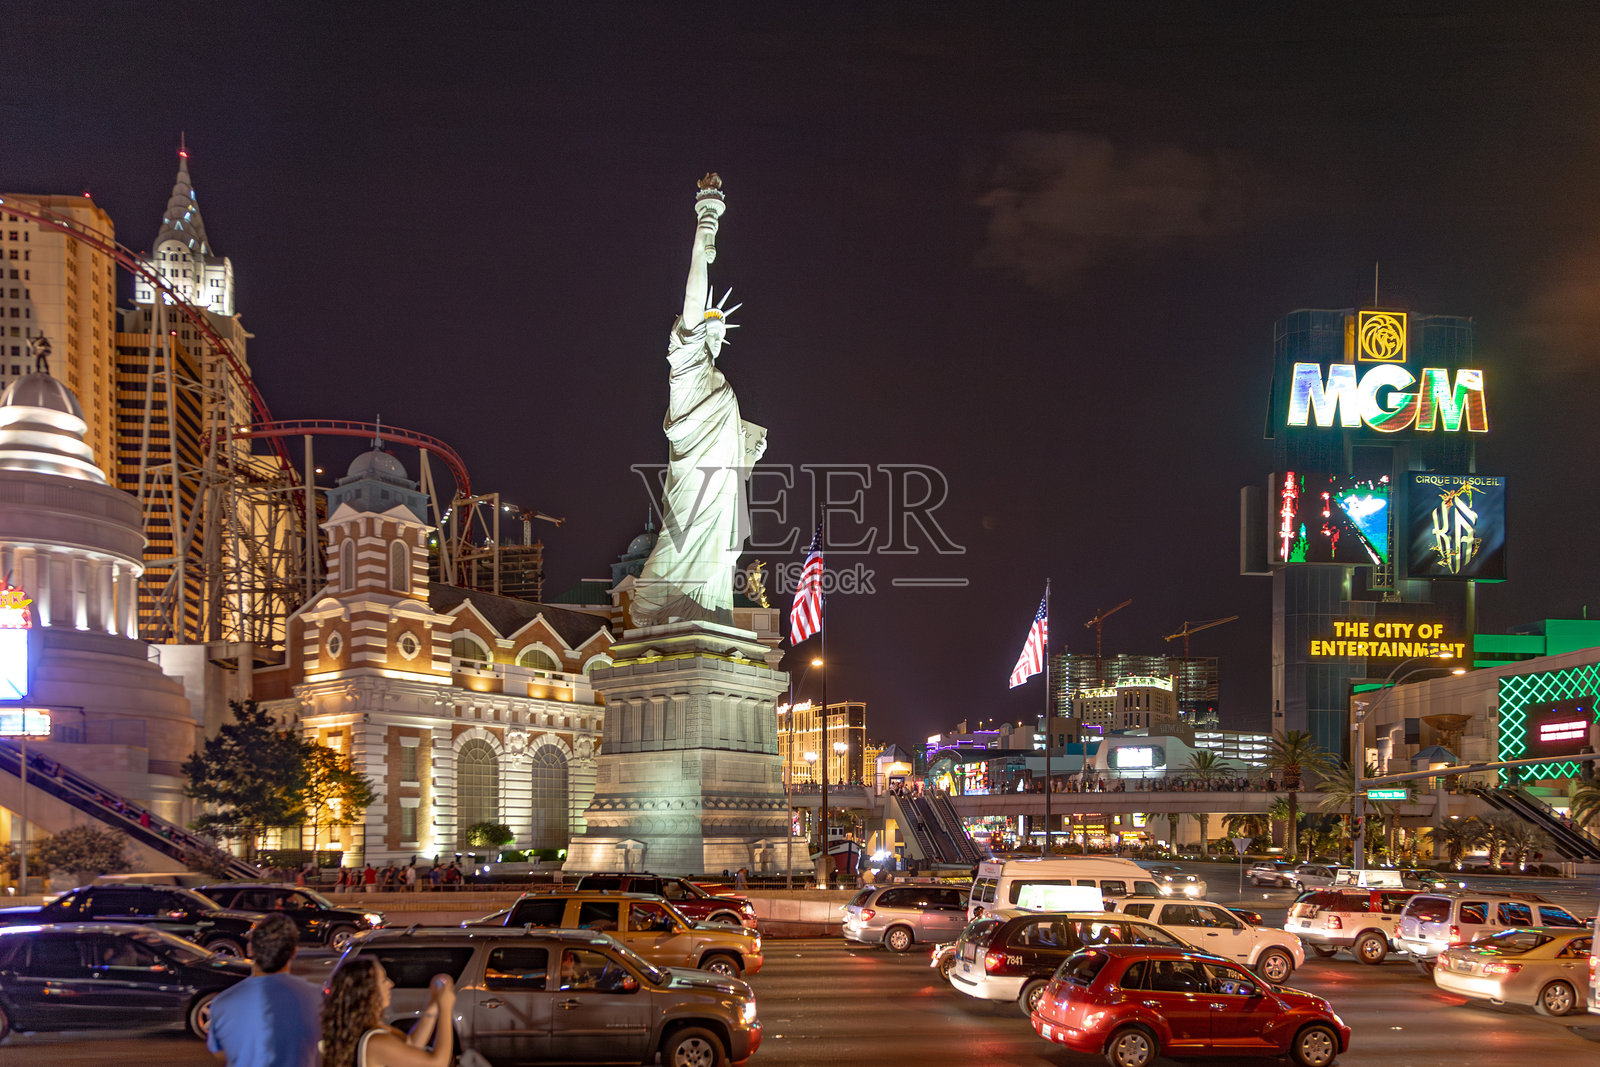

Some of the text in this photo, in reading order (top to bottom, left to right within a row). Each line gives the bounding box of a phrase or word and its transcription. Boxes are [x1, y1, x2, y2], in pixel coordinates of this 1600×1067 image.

[1287, 362, 1488, 433] MGM
[1415, 475, 1500, 486] CIRQUE DU SOLEIL
[1334, 622, 1443, 639] THE CITY OF
[1311, 641, 1465, 658] ENTERTAINMENT
[1006, 955, 1023, 965] 7841
